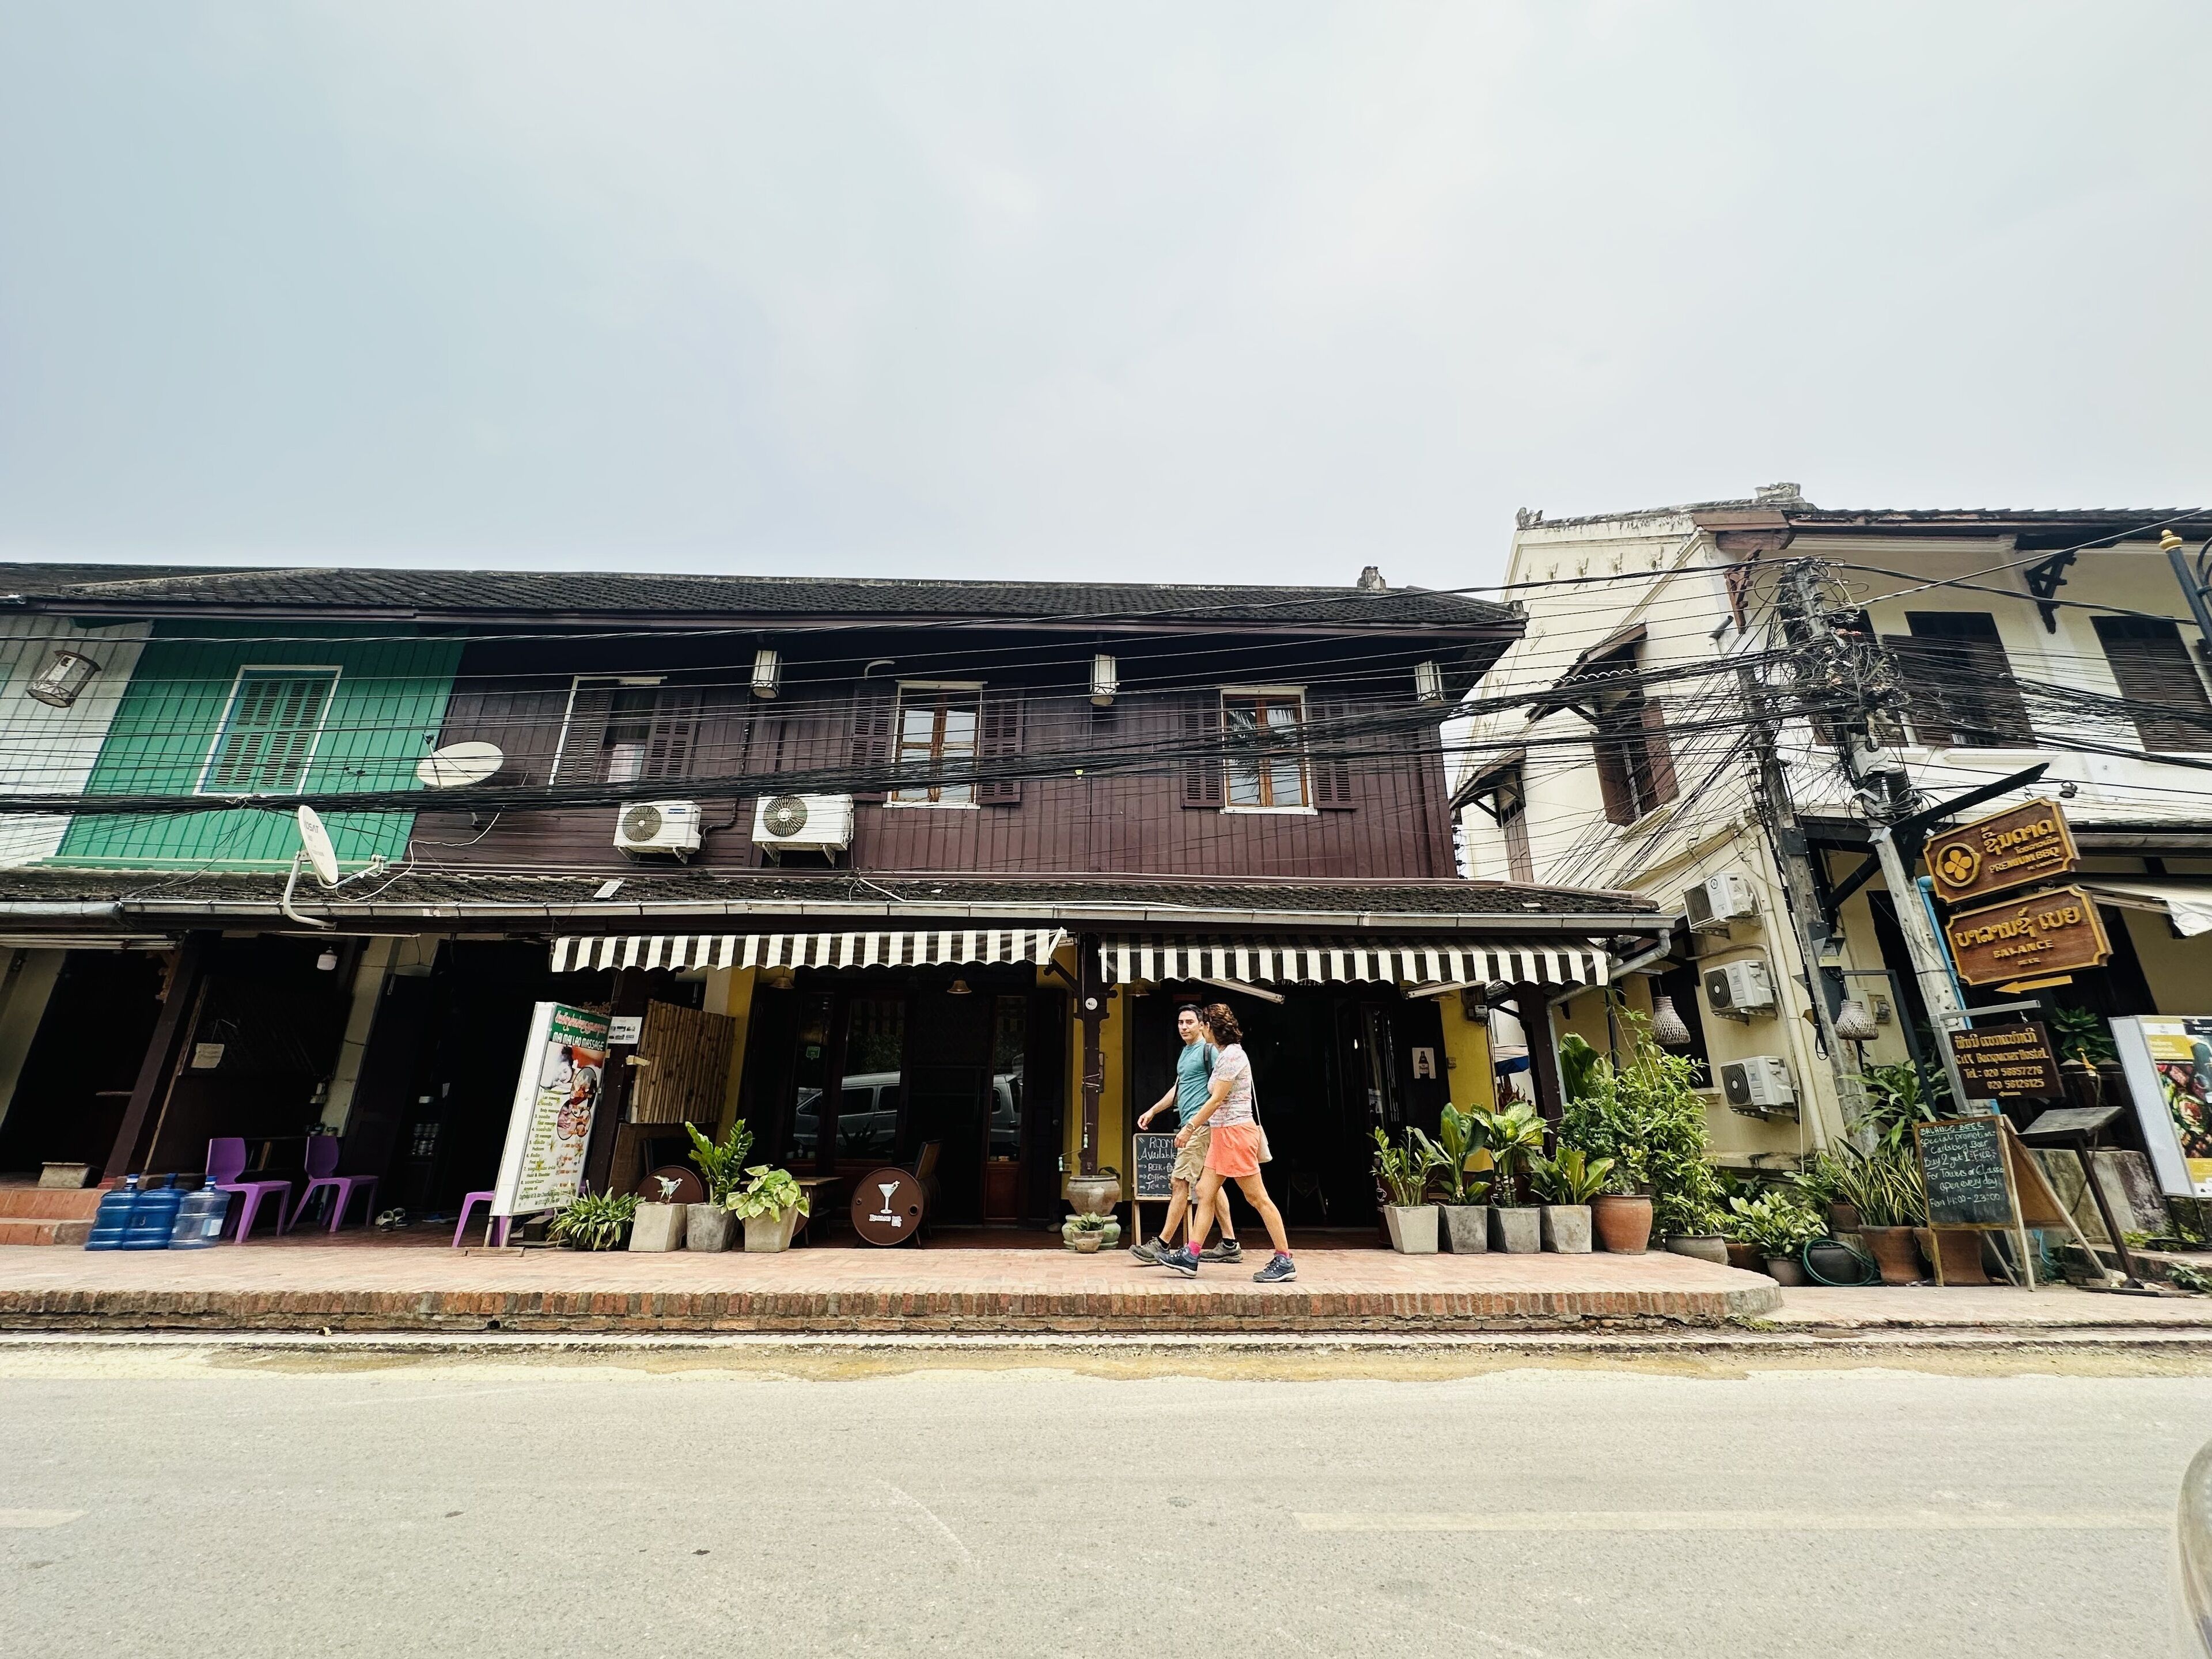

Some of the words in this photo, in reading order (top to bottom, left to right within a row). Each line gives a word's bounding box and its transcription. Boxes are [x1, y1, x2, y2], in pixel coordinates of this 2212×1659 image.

[1989, 853, 2036, 873] PREMIUM
[2036, 846, 2061, 861] BBQ
[1993, 940, 2055, 959] BALANCE
[552, 1031, 563, 1043] MAI
[562, 1033, 573, 1045] MAI
[572, 1036, 582, 1047] LAO
[581, 1038, 604, 1051] MASSAGE
[1983, 1069, 1999, 1078] 020
[1986, 1081, 2003, 1089] 020
[1919, 1125, 1955, 1137] BALANCE
[1959, 1122, 1984, 1131] BEER
[1930, 1144, 1968, 1154] Carlsberg
[1969, 1140, 1989, 1149] Beer
[1924, 1156, 1941, 1168] Buy
[1941, 1153, 1949, 1166] 2
[1949, 1154, 1964, 1168] get
[1963, 1151, 1971, 1162] 1
[1939, 1168, 1967, 1178] Towers
[1145, 1180, 1160, 1191] Tea
[1960, 1177, 1982, 1188] every
[1983, 1175, 1998, 1187] day
[1973, 1194, 2001, 1203] 23:00
